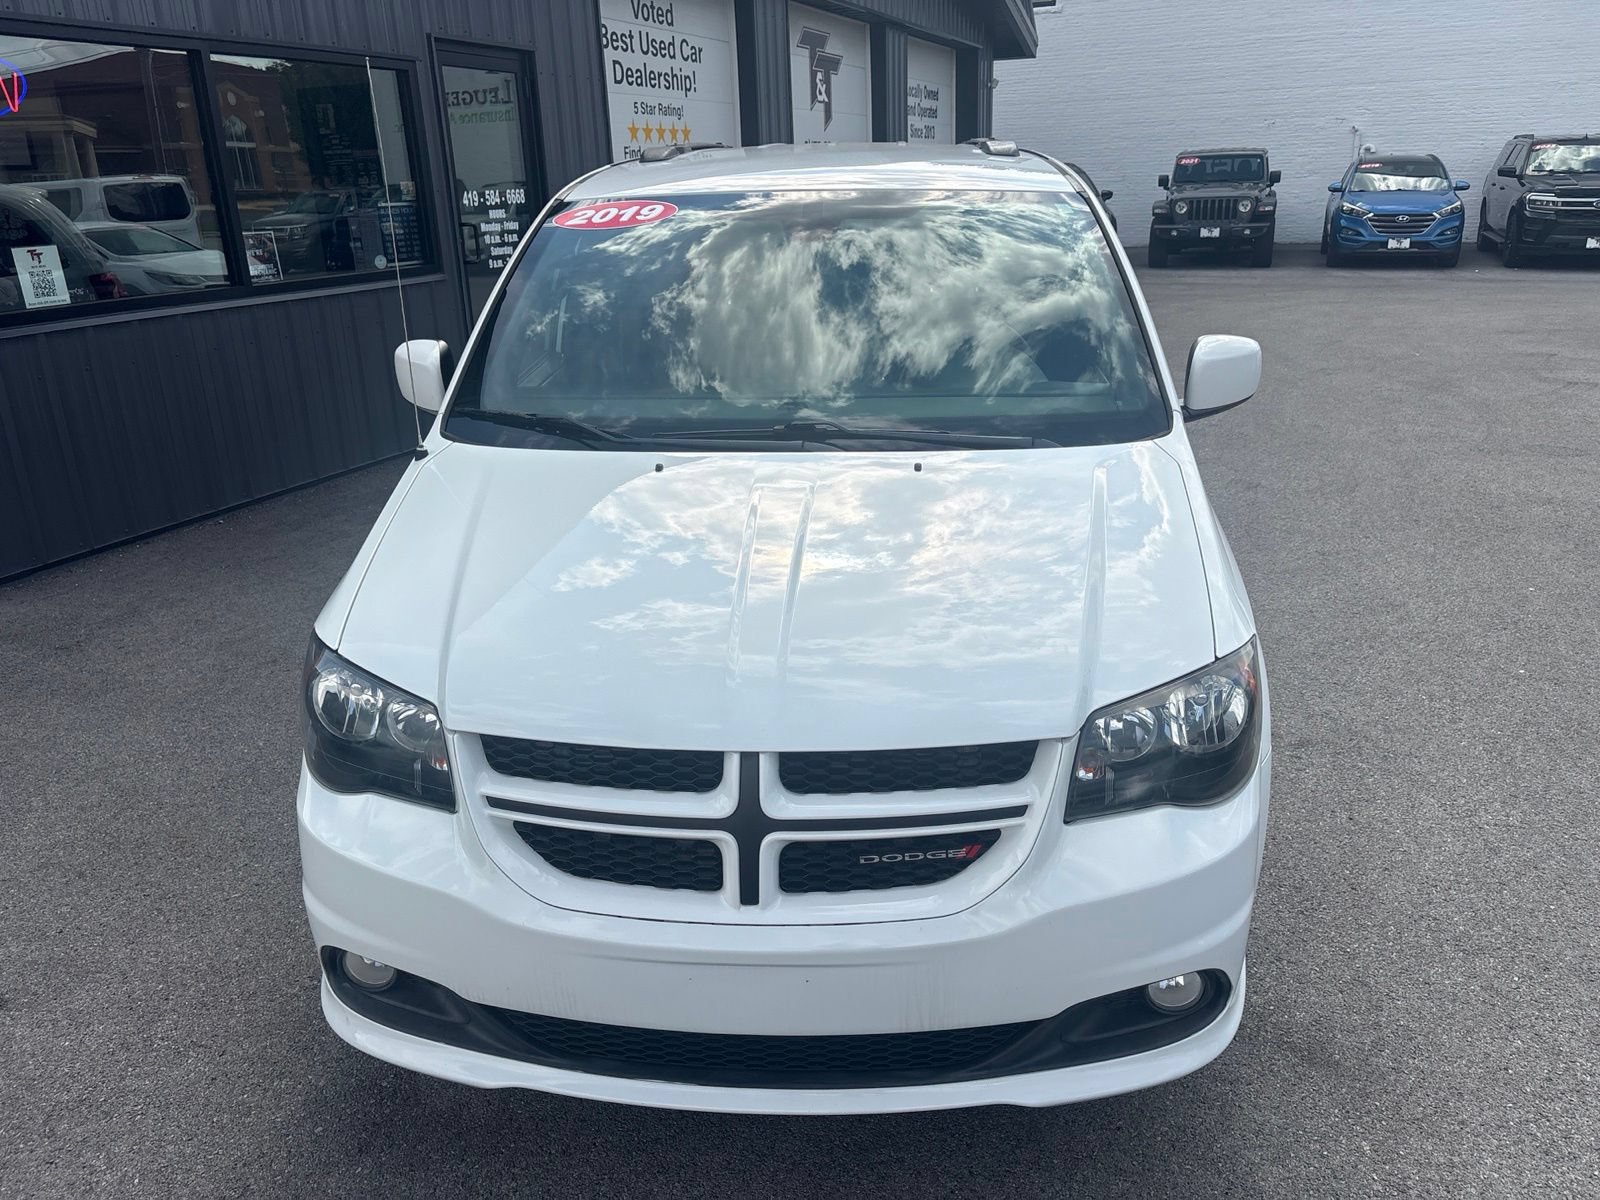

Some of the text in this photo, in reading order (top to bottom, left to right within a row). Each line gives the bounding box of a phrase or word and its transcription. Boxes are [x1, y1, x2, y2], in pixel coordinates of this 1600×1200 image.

[631, 0, 674, 27] Voted
[601, 24, 703, 64] Best Used Car
[612, 60, 697, 97] Dealership!
[907, 83, 939, 102] ocally Owned
[633, 102, 684, 120] 5 Star Rating!
[917, 102, 938, 121] Operated
[910, 123, 923, 139] Since
[462, 188, 526, 207] 419 584 6668
[488, 209, 506, 219] HOURS
[564, 204, 665, 225] 2019
[480, 221, 501, 232] Monday
[504, 220, 519, 231] Friday
[484, 234, 490, 244] 10
[490, 245, 513, 256] Saturday
[488, 258, 493, 269] 9
[859, 848, 967, 864] DODGE
